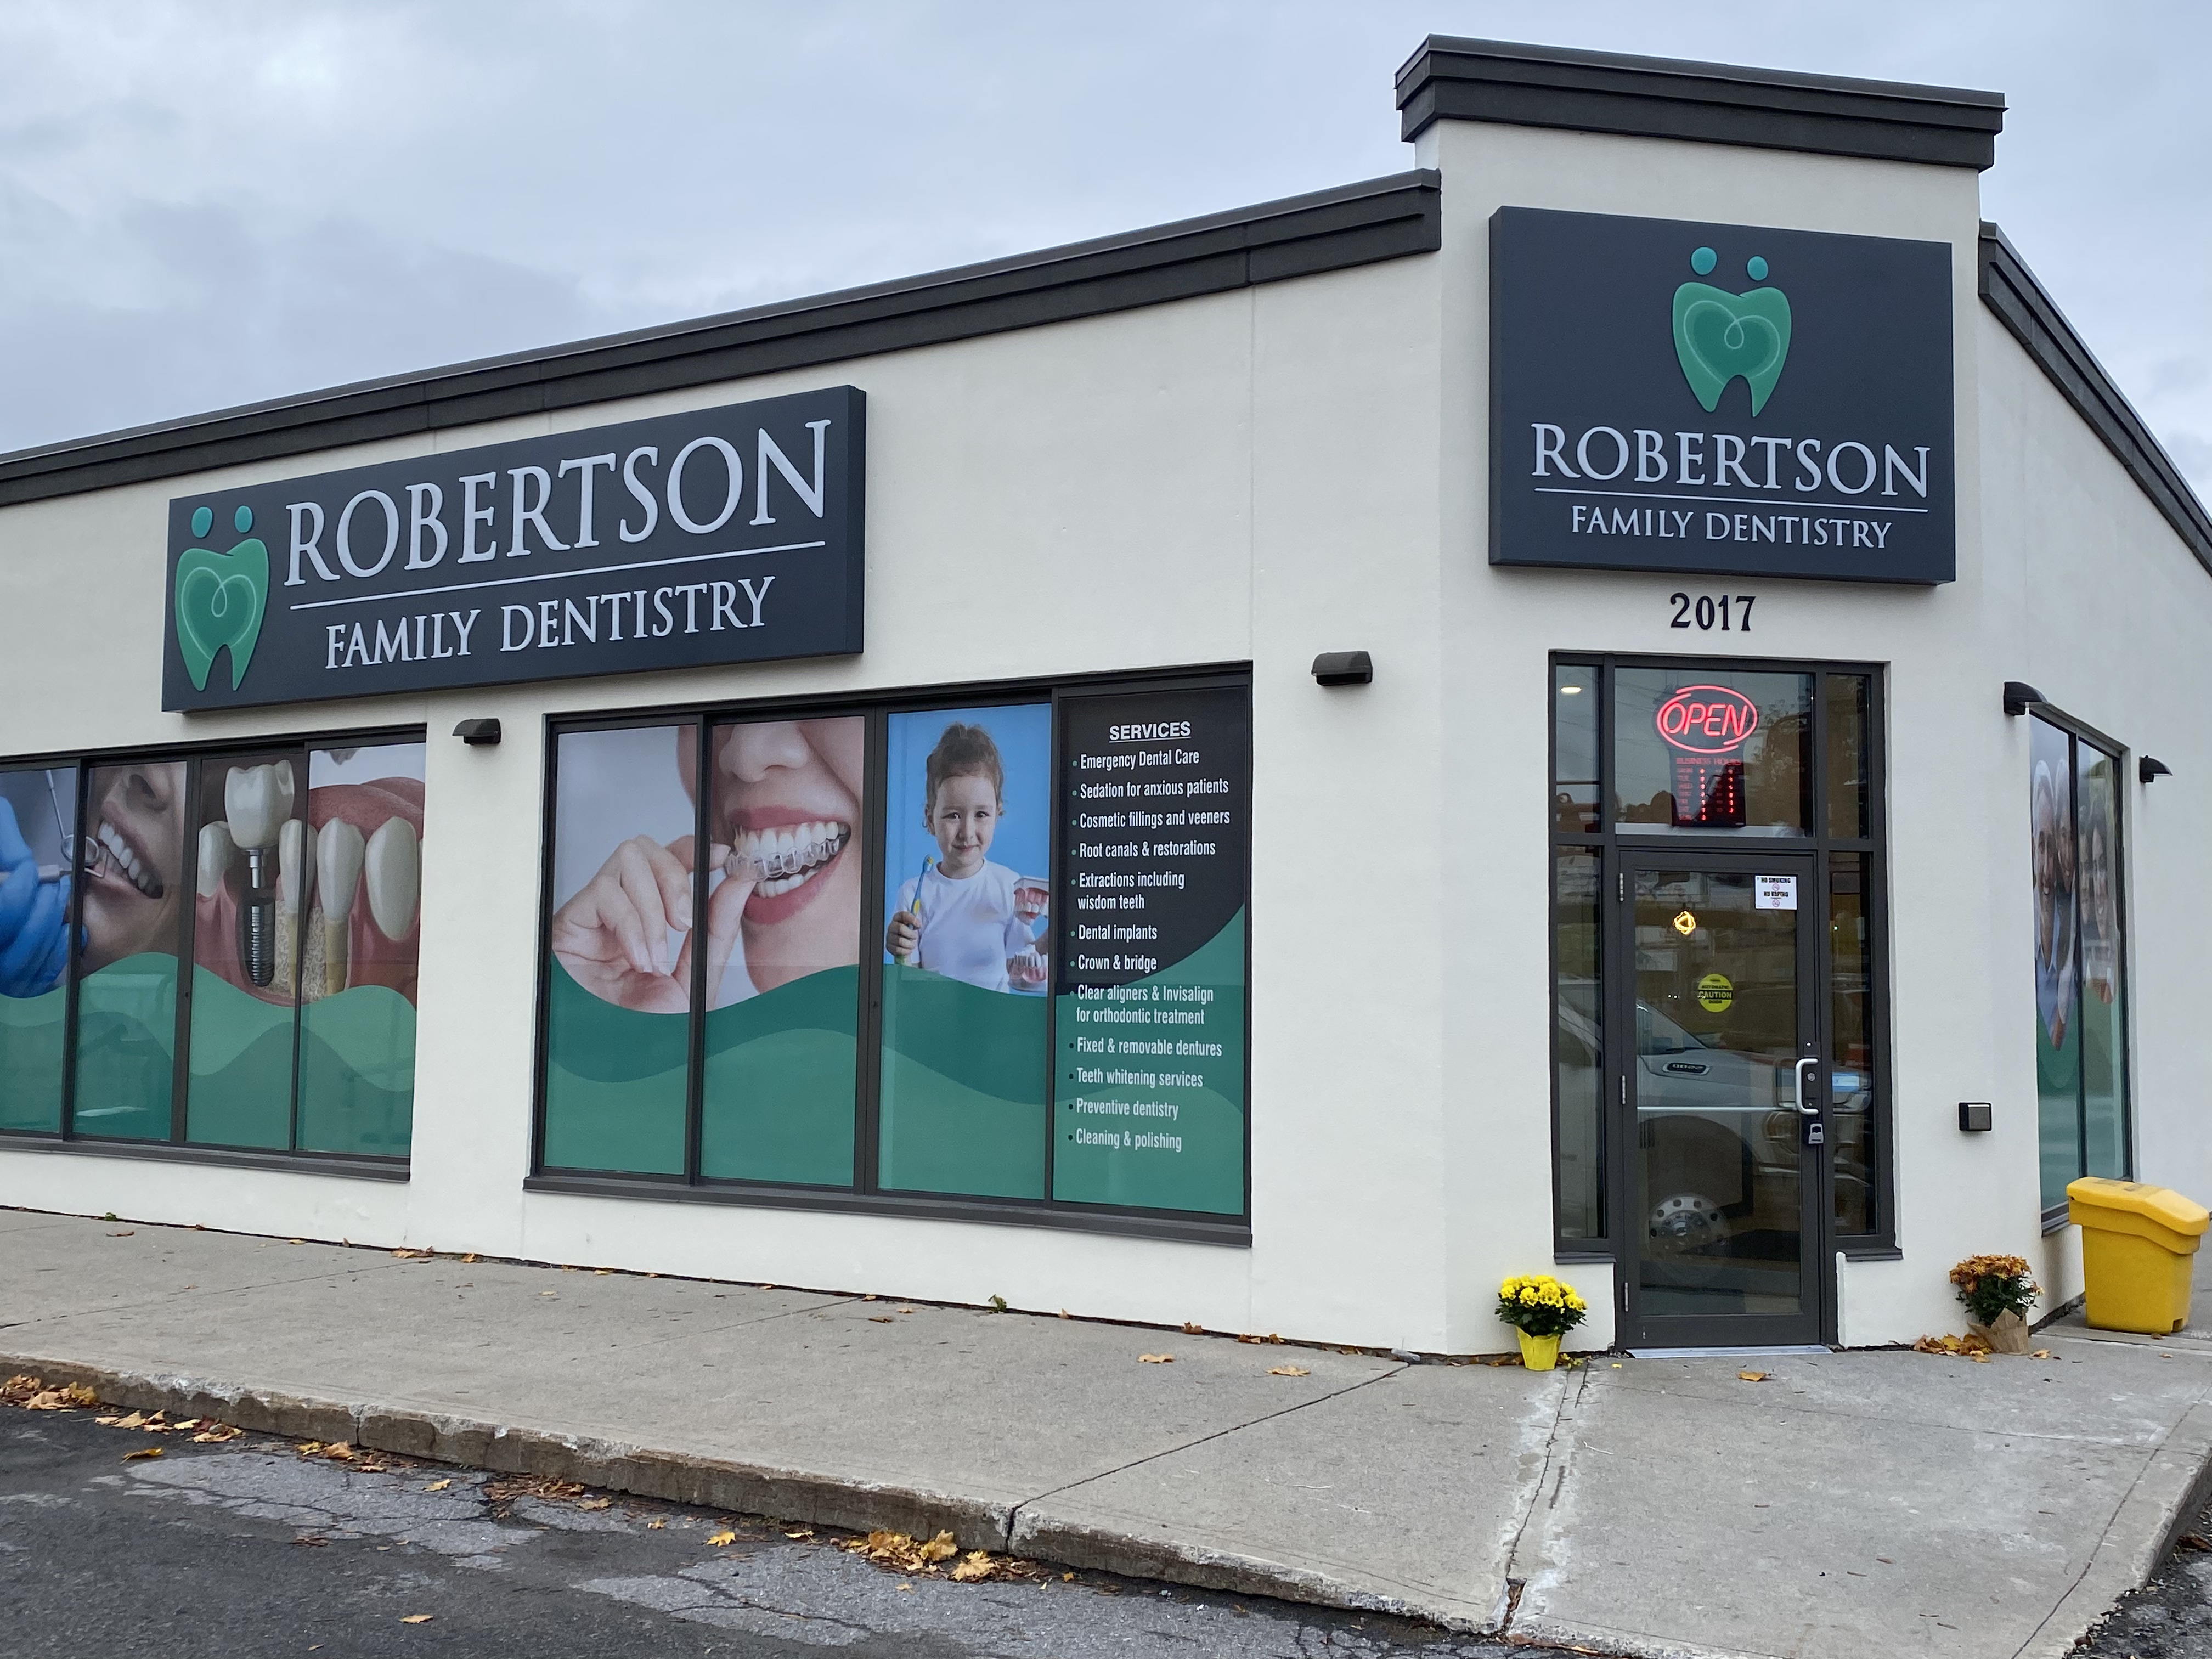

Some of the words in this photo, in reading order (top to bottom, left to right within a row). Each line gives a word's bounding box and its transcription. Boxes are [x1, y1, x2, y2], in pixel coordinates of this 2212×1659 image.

[1531, 424, 1930, 497] ROBERTSON
[284, 420, 831, 585] ROBERTSON
[1573, 506, 1693, 538] FAMILY
[1706, 513, 1892, 548] DENTISTRY
[325, 610, 481, 668] FAMILY
[500, 576, 775, 651] DENTISTRY
[1670, 592, 1756, 631] 2017
[1662, 702, 1748, 737] OPEN
[1109, 721, 1192, 741] SERVICES
[1080, 754, 1136, 771] Emergency
[1139, 749, 1172, 766] Dental
[1175, 748, 1199, 765] Care
[1080, 782, 1124, 799] Sedation
[1126, 781, 1141, 797] for
[1144, 780, 1184, 796] anxious
[1187, 778, 1229, 798] patients
[1080, 811, 1126, 828] Cosmetic
[1128, 811, 1163, 830] fillings
[1166, 809, 1185, 826] and
[1188, 811, 1230, 825] veeners
[1080, 843, 1103, 858] Root
[1105, 842, 1138, 857] canals
[1142, 841, 1150, 856] &
[1153, 839, 1216, 856] restorations
[1079, 872, 1135, 888] Extractions
[1138, 871, 1184, 890] including
[1077, 894, 1116, 910] wisdom
[1119, 894, 1145, 910] teeth
[1079, 924, 1110, 940] Dental
[1114, 924, 1158, 943] implants
[1078, 954, 1110, 970] Crown
[1113, 955, 1121, 970] &
[1124, 954, 1157, 973] bridge
[1077, 984, 1104, 1000] Clear
[1107, 985, 1148, 1004] aligners
[1151, 985, 1160, 1001] &
[1163, 985, 1214, 1005] Invisalign
[1076, 1006, 1091, 1022] for
[1093, 1007, 1151, 1024] orthodontic
[1153, 1008, 1205, 1025] treatment
[1077, 1036, 1104, 1053] Fixed
[1107, 1037, 1115, 1053] &
[1119, 1039, 1173, 1055] removable
[1176, 1039, 1222, 1057] dentures
[1076, 1067, 1103, 1084] Teeth
[1106, 1068, 1156, 1089] whitening
[1159, 1070, 1203, 1087] services
[1076, 1097, 1130, 1115] Preventive
[1133, 1100, 1179, 1121] dentistry
[1076, 1128, 1120, 1149] Cleaning
[1123, 1130, 1131, 1147] &
[1135, 1132, 1182, 1153] polishing
